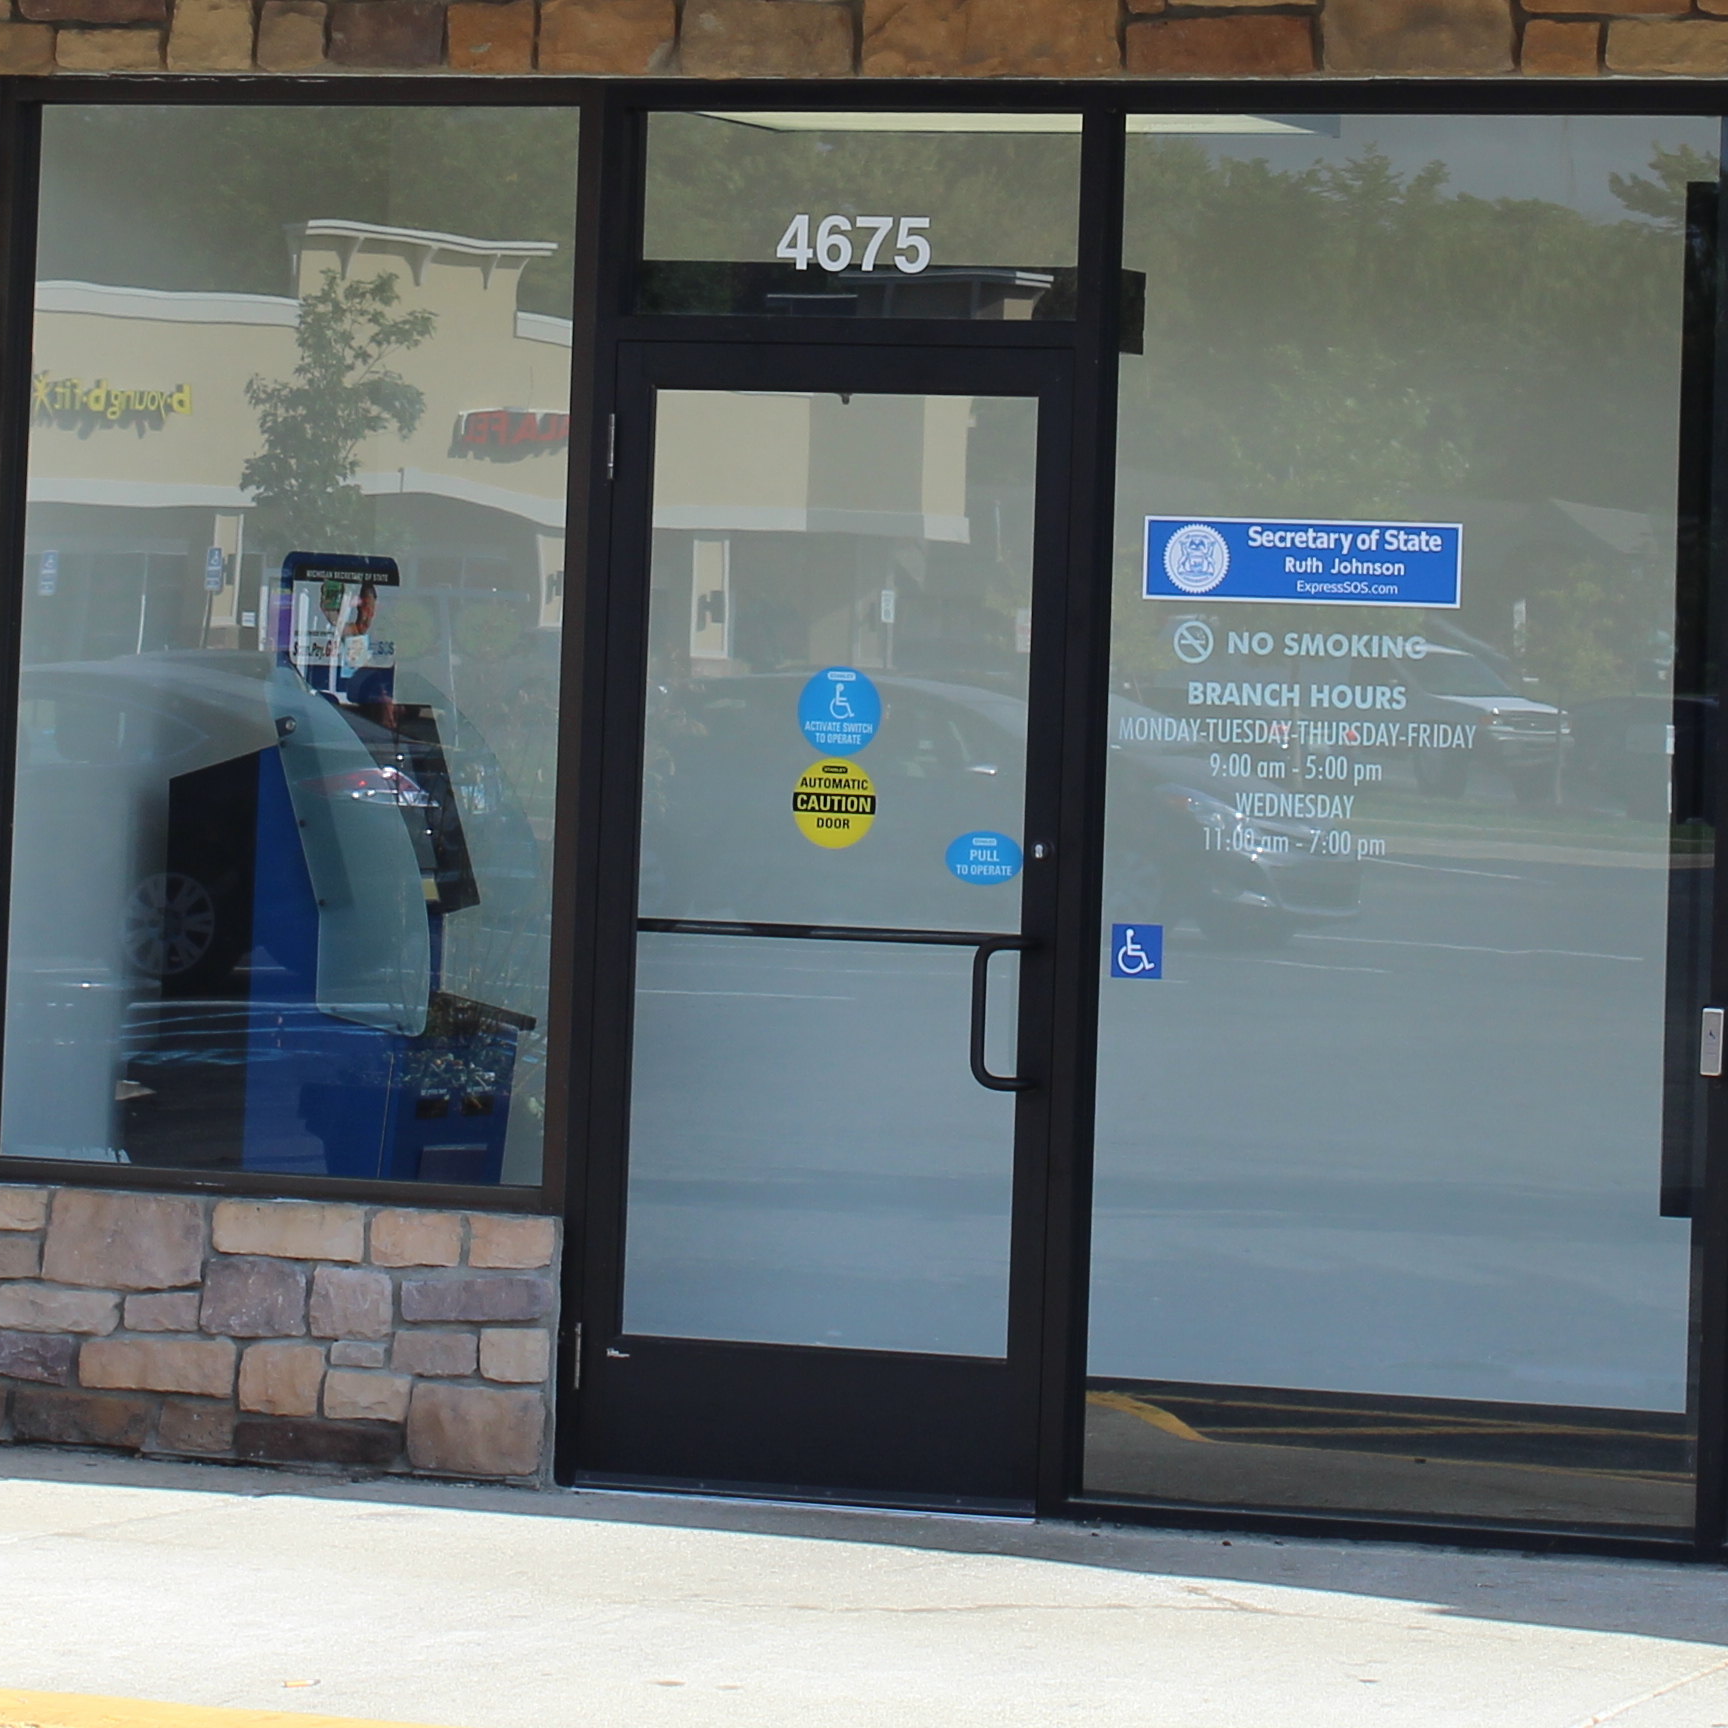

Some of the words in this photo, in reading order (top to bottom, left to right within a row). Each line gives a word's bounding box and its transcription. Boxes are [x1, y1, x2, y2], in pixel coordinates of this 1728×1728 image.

[775, 213, 932, 274] 4675
[1247, 525, 1354, 555] Secretary
[1355, 528, 1382, 552] of
[1383, 528, 1444, 553] State
[1284, 556, 1324, 574] Ruth
[1330, 557, 1406, 577] Johnson
[1296, 579, 1399, 596] ExpressSOS.com
[1227, 630, 1275, 656] NO
[1282, 632, 1429, 661] SMOKING
[1187, 681, 1300, 708] BRANCH
[1310, 684, 1408, 711] HOURS
[804, 721, 841, 733] ACTIVATE
[842, 722, 873, 734] SWITCH
[815, 732, 826, 744] TO
[827, 733, 862, 745] OPERATE
[1209, 752, 1252, 779] 9:00
[1256, 758, 1286, 780] am
[1305, 754, 1348, 782] 5:00
[1353, 760, 1383, 787] pm
[800, 776, 869, 791] AUTOMATIC
[796, 793, 872, 813] CAUTION
[1235, 791, 1355, 820] WEDNESDAY
[816, 817, 851, 830] DOOR
[1203, 826, 1255, 853] 11:00
[1260, 831, 1289, 854] am
[1309, 829, 1352, 855] 7:00
[1356, 835, 1386, 861] pm
[969, 849, 1001, 862] PULL
[956, 864, 968, 875] TO
[970, 864, 1013, 877] OPERATE
